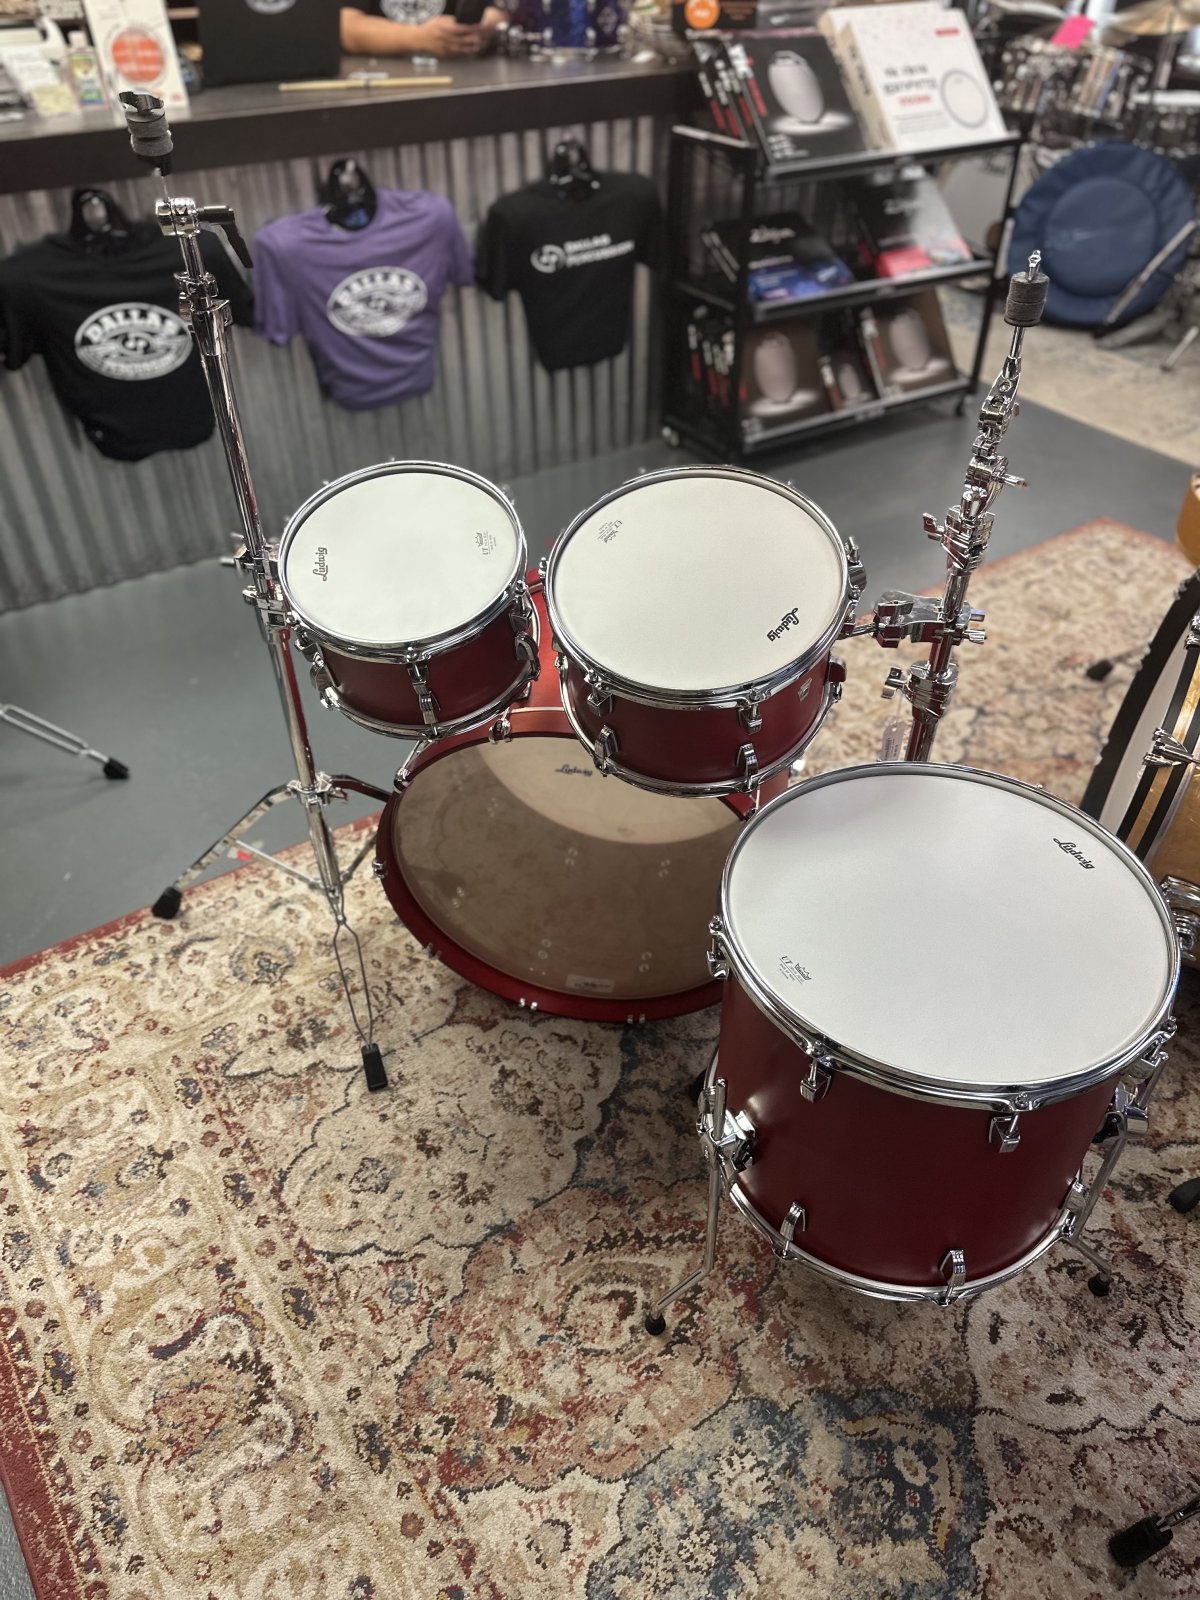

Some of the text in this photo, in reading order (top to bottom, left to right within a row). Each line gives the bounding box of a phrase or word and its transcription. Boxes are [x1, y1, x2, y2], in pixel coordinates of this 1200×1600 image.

[338, 272, 415, 306] DALLAS
[84, 308, 180, 345] DALLAS
[312, 546, 329, 582] Ludwig
[767, 607, 799, 641] Ludwig
[1053, 838, 1095, 869] Ludwig
